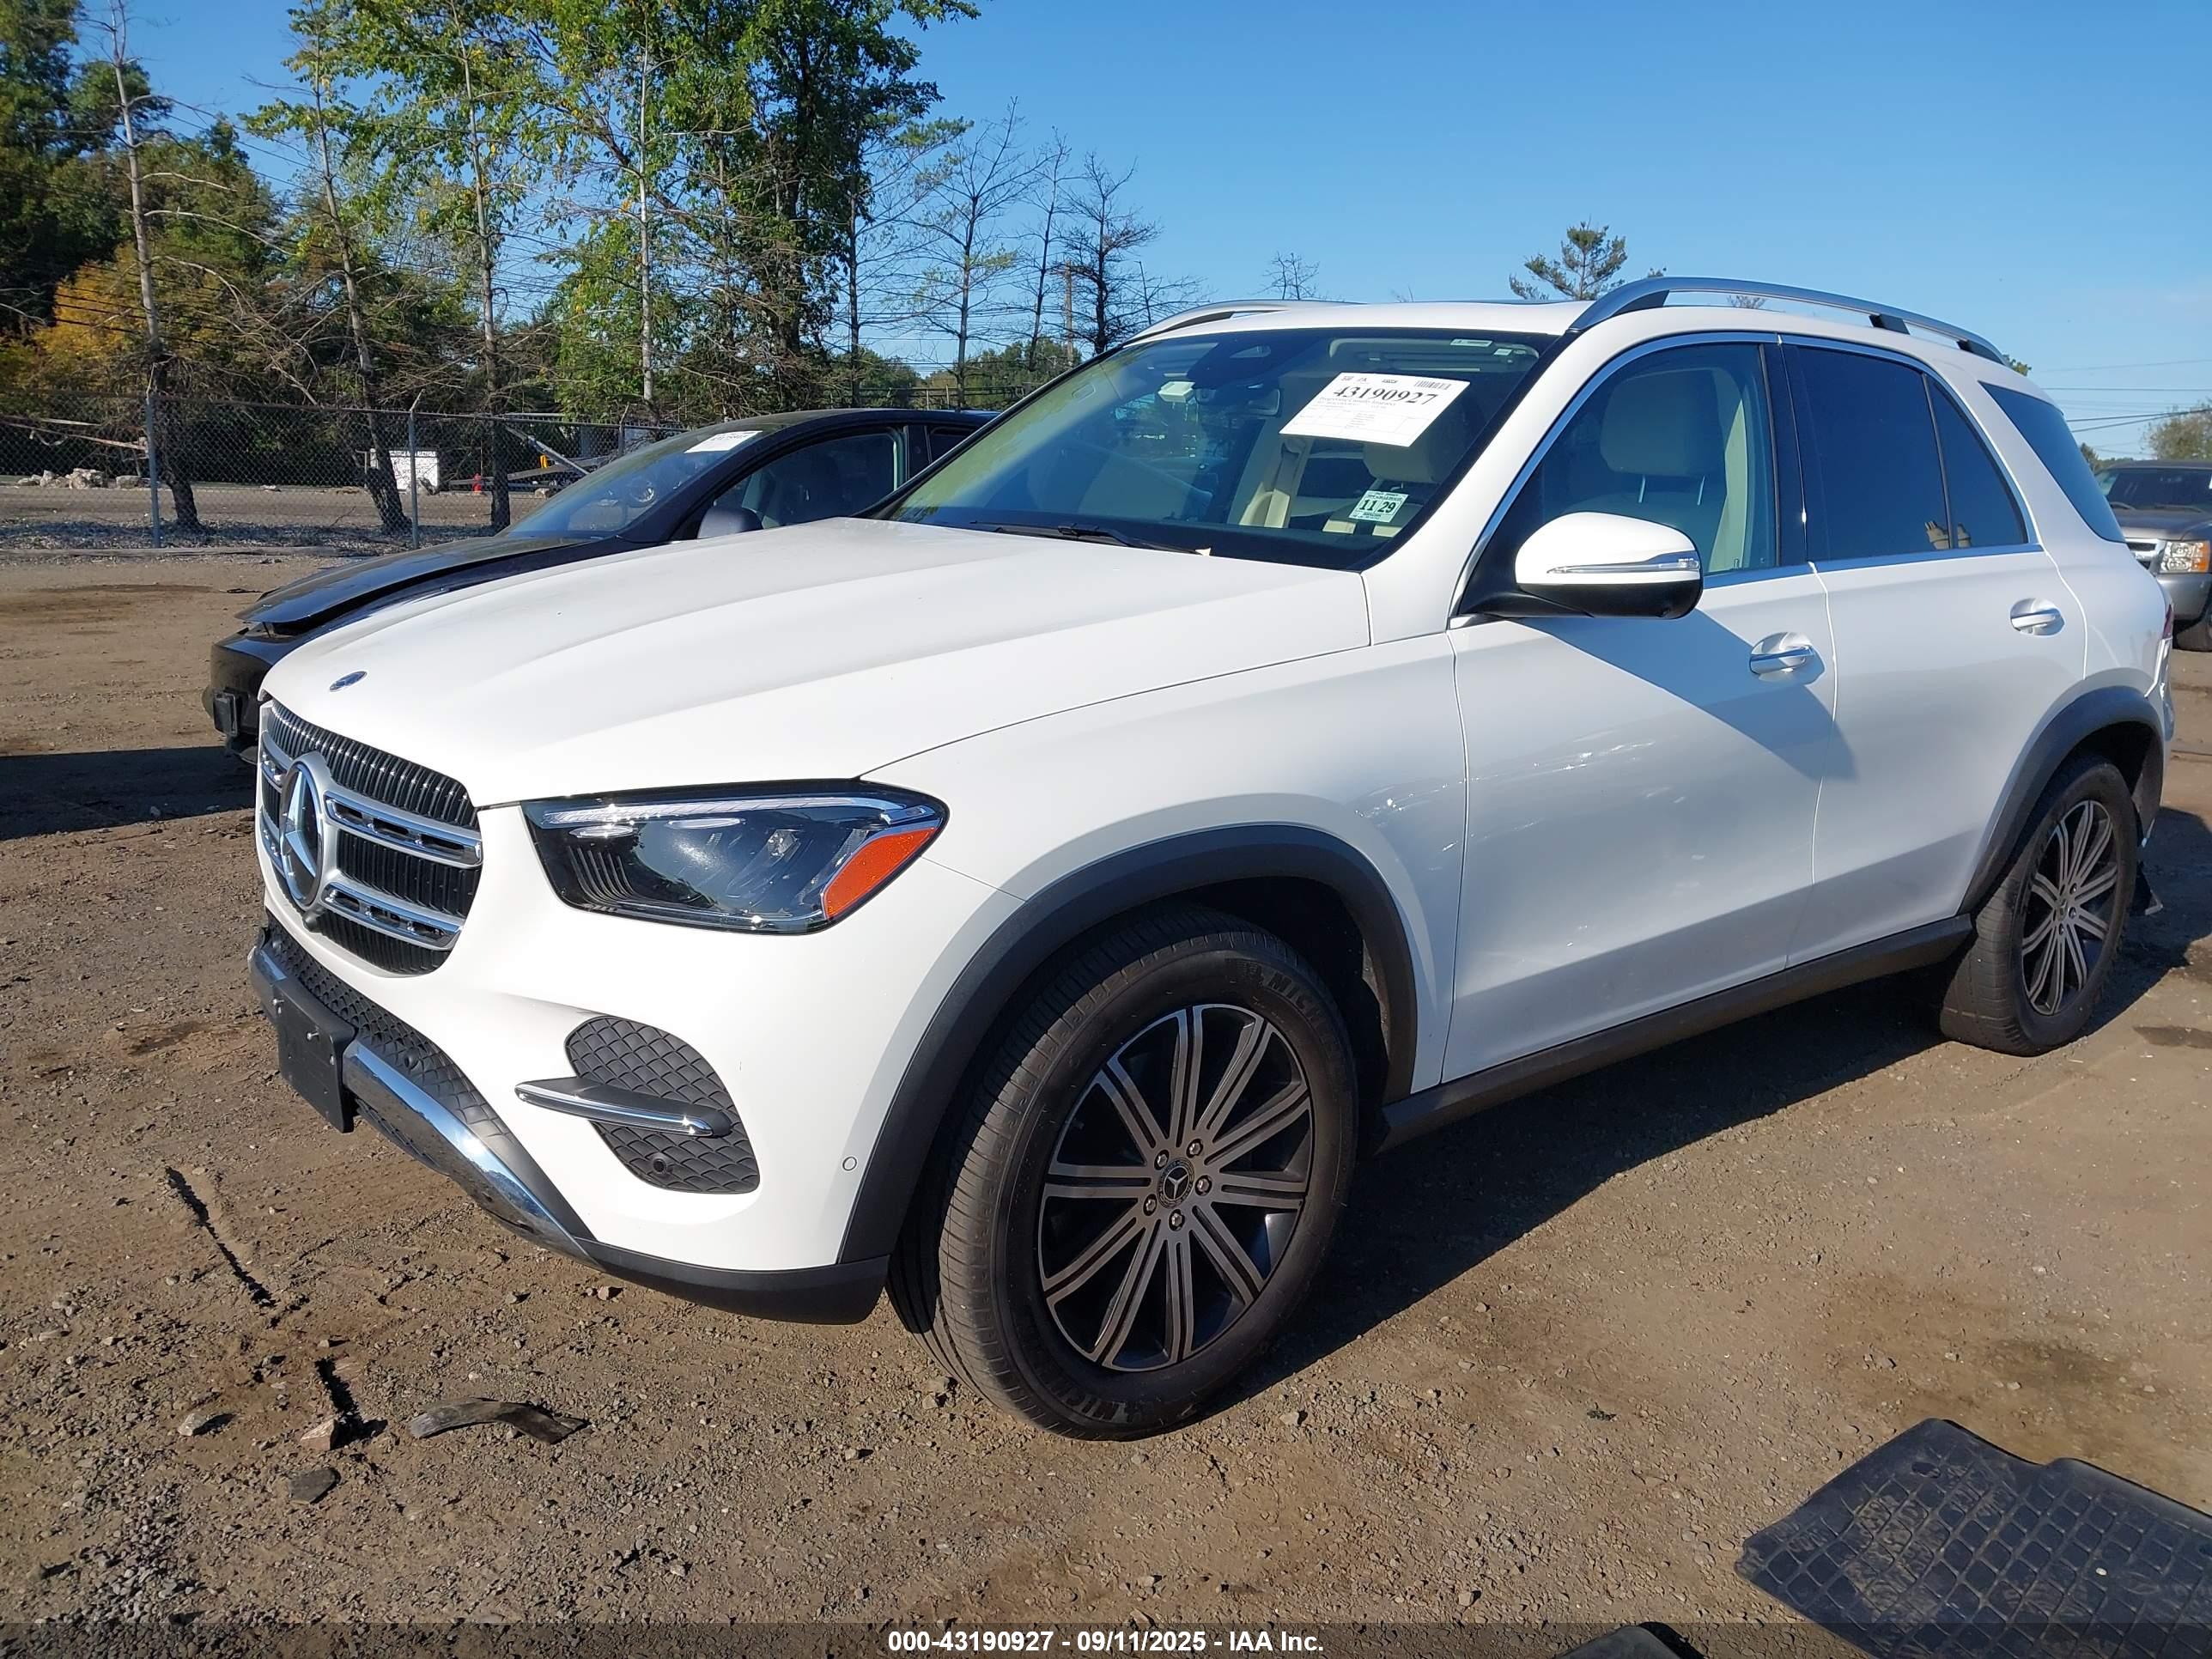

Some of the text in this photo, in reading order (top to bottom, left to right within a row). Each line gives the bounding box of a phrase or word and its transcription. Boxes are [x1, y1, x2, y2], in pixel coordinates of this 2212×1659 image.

[1334, 386, 1438, 405] 43190927
[1359, 499, 1397, 514] 11 29
